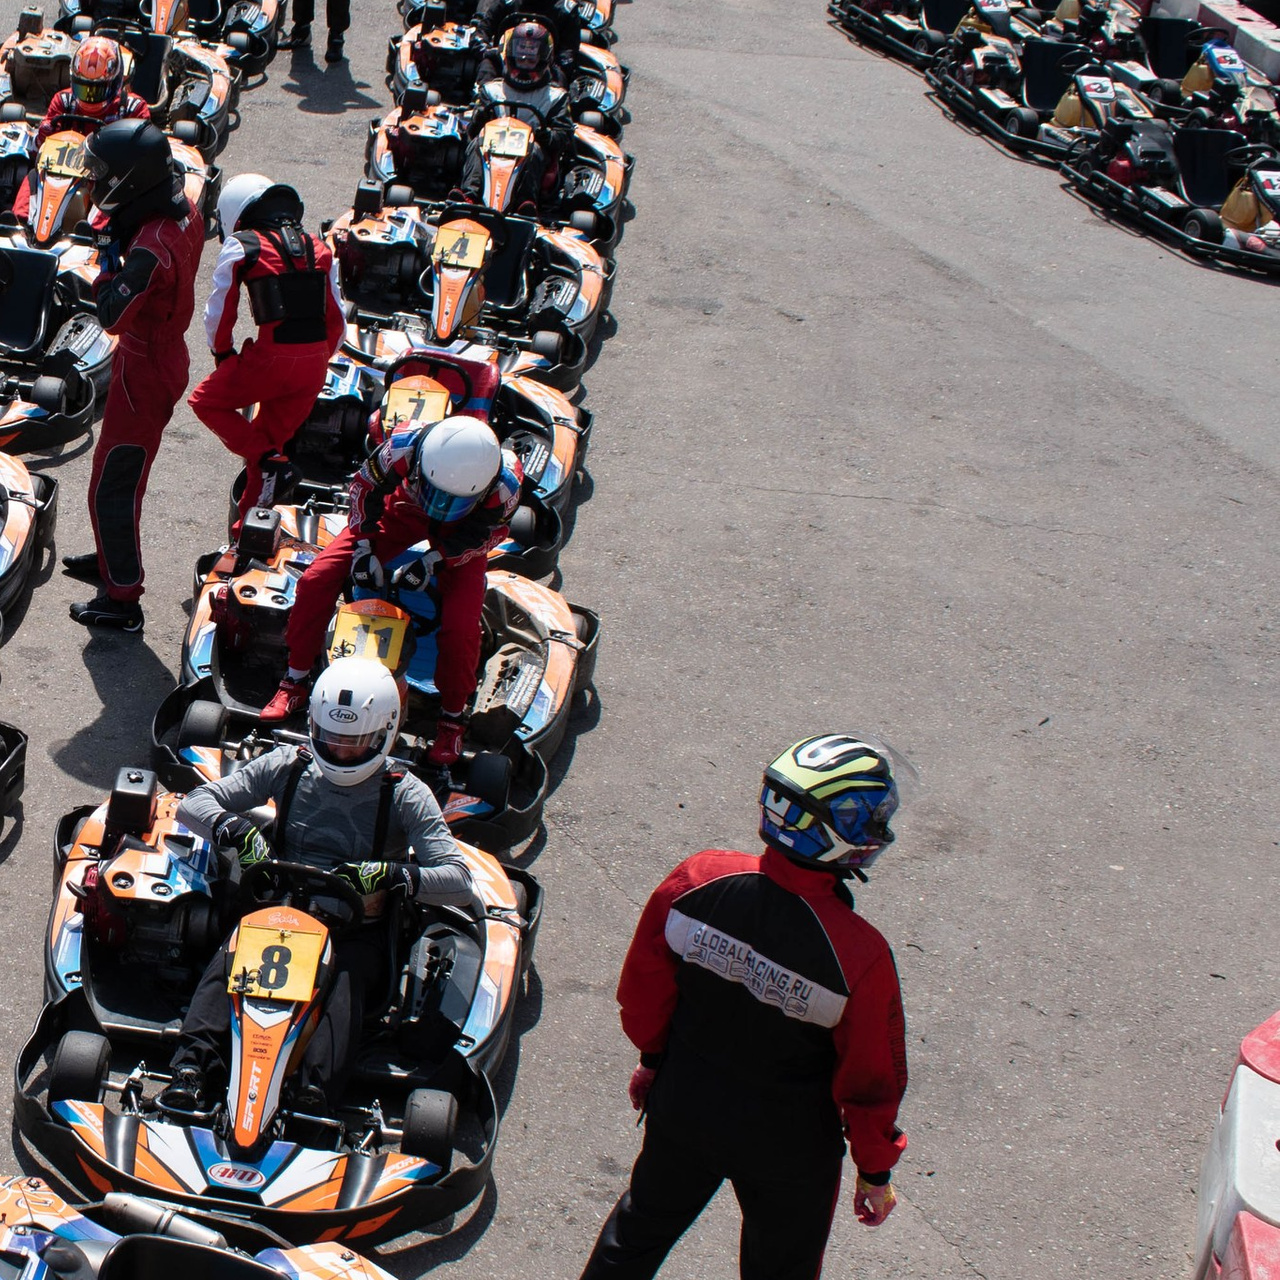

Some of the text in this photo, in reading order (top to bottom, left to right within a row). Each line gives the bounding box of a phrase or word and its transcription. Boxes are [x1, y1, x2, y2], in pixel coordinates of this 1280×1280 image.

[494, 131, 525, 148] 13
[449, 237, 470, 260] 4
[408, 398, 426, 420] 7
[351, 624, 393, 659] 11
[331, 709, 355, 721] Arai
[259, 945, 292, 990] 8
[693, 927, 813, 1001] GLOBALRACING.RU
[242, 1061, 263, 1133] SPORT
